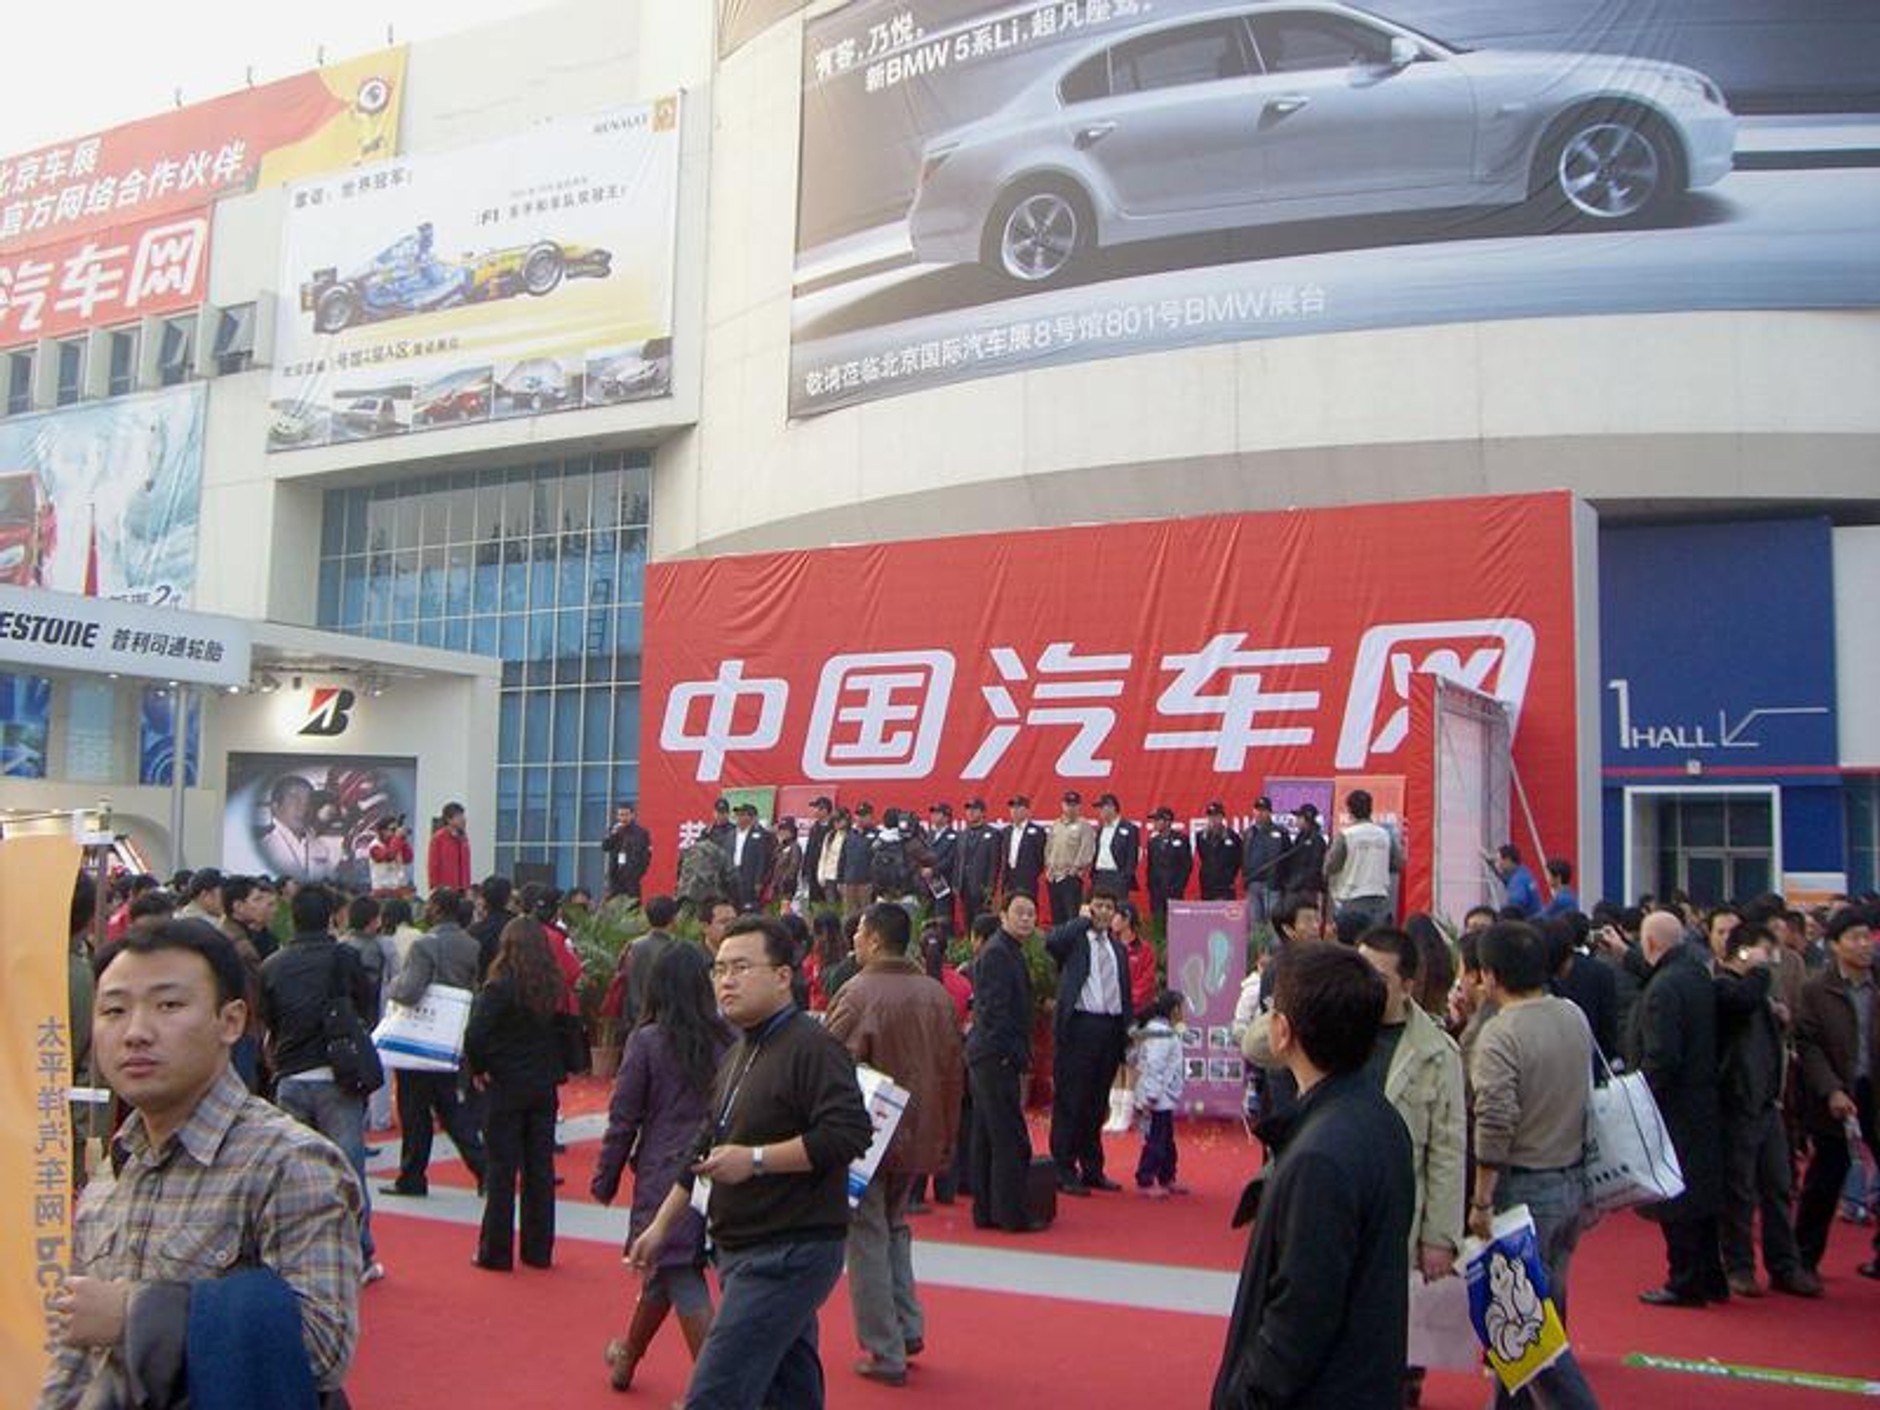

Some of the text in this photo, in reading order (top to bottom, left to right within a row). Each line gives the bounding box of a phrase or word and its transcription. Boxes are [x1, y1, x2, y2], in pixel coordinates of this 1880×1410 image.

[112, 628, 224, 662] 普利司通轮胎
[660, 618, 1535, 782] 中国汽车网
[1632, 727, 1714, 749] HALL
